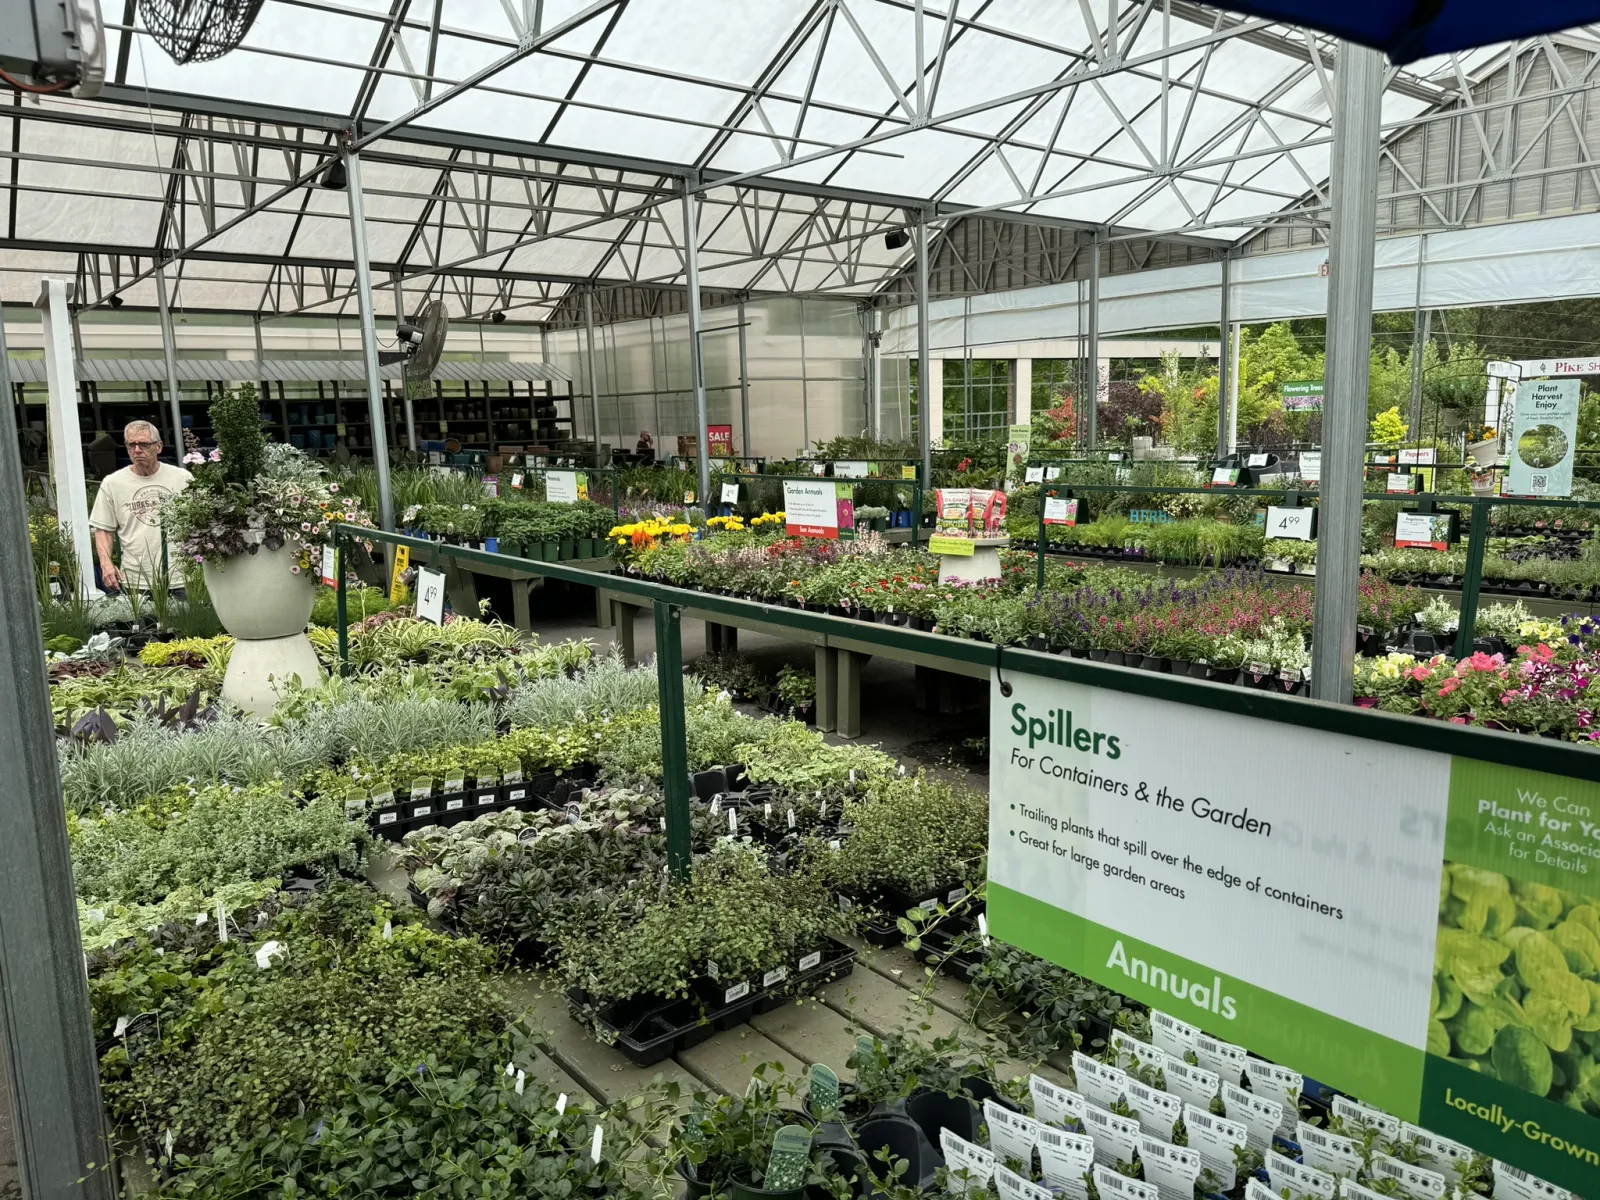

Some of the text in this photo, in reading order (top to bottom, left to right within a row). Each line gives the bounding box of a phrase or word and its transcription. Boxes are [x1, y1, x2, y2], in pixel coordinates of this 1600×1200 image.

[1283, 384, 1309, 393] Flowering
[1537, 384, 1558, 392] Plant
[1535, 401, 1558, 410] Enjoy
[708, 432, 730, 441] SALE
[787, 486, 823, 496] Garden Annuals
[808, 527, 825, 535] Annuals
[1278, 516, 1300, 530] 499
[424, 585, 437, 605] 499
[1010, 702, 1121, 760] Spillers
[1010, 748, 1272, 837] For Containers & the Garden
[1516, 788, 1590, 818] We Can
[1478, 799, 1533, 824] Plant
[1539, 811, 1572, 832] for
[1483, 821, 1512, 839] Ask
[1516, 831, 1536, 844] an
[1018, 830, 1186, 900] Great for large garden areas
[1019, 803, 1344, 920] Trailing plants that spill over the edge of containers
[1509, 842, 1588, 875] for Details
[1105, 939, 1237, 1021] Annuals
[1444, 1087, 1600, 1167] Locally-Grown
